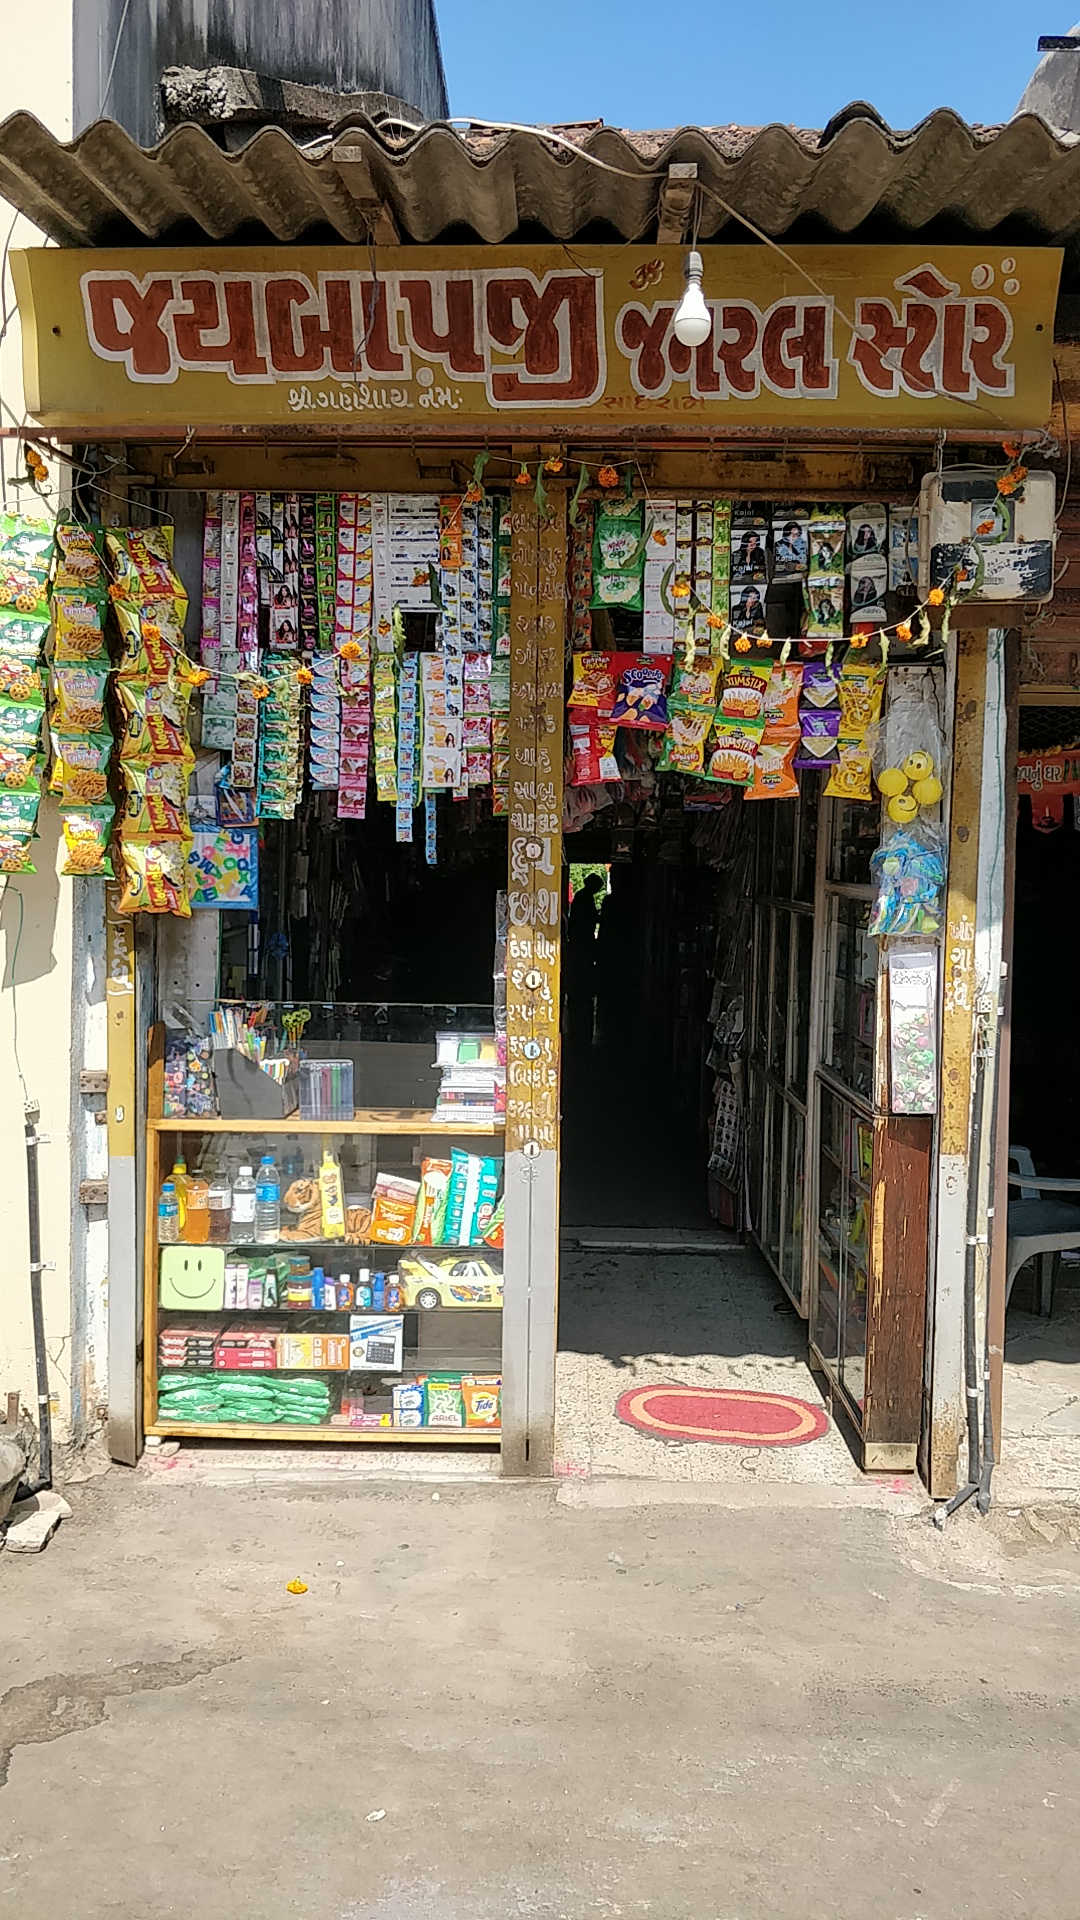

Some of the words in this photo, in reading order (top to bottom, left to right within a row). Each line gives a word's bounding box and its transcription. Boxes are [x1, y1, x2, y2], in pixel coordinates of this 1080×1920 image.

[616, 296, 839, 400] જનરલ
[848, 262, 1015, 400] સ્ટોર
[1044, 765, 1062, 782] ઘર
[475, 1400, 494, 1412] Tide
[431, 1414, 459, 1422] ARIEL
